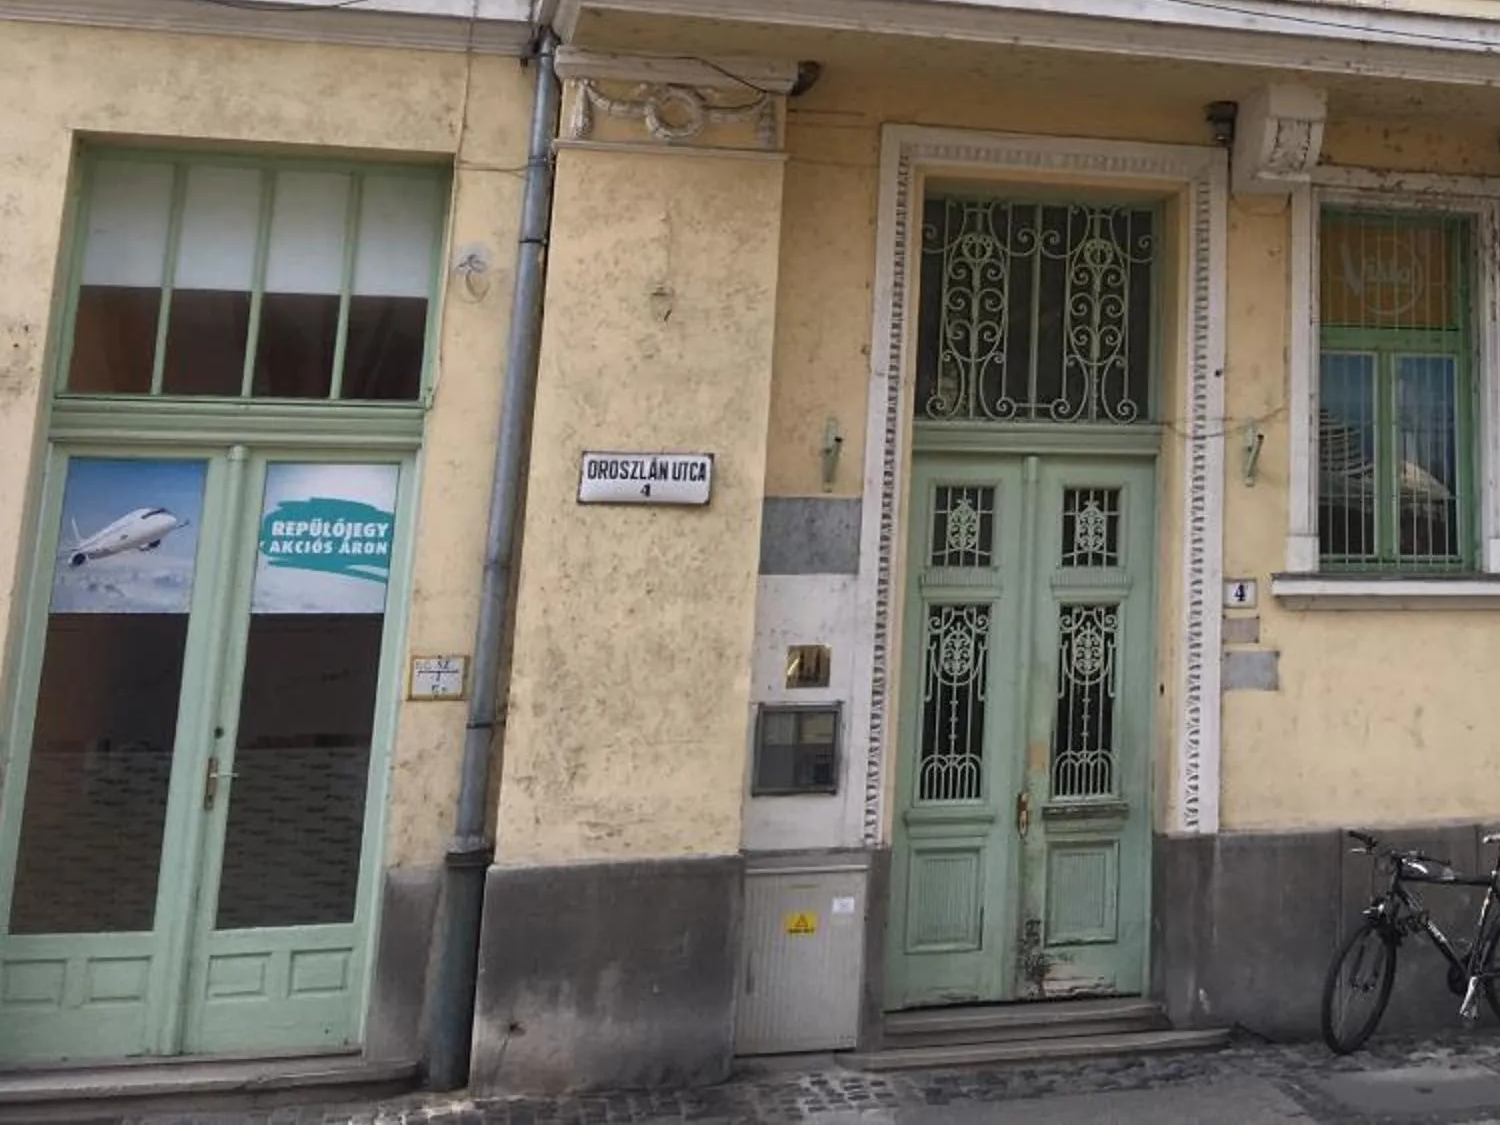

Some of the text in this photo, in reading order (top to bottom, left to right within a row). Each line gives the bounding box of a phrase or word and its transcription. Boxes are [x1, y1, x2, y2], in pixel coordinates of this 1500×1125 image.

[587, 457, 707, 482] OROSZLÁN UTCA
[640, 483, 651, 497] 4
[269, 537, 387, 555] AKCIÓS ÁRON
[1234, 584, 1246, 602] 4
